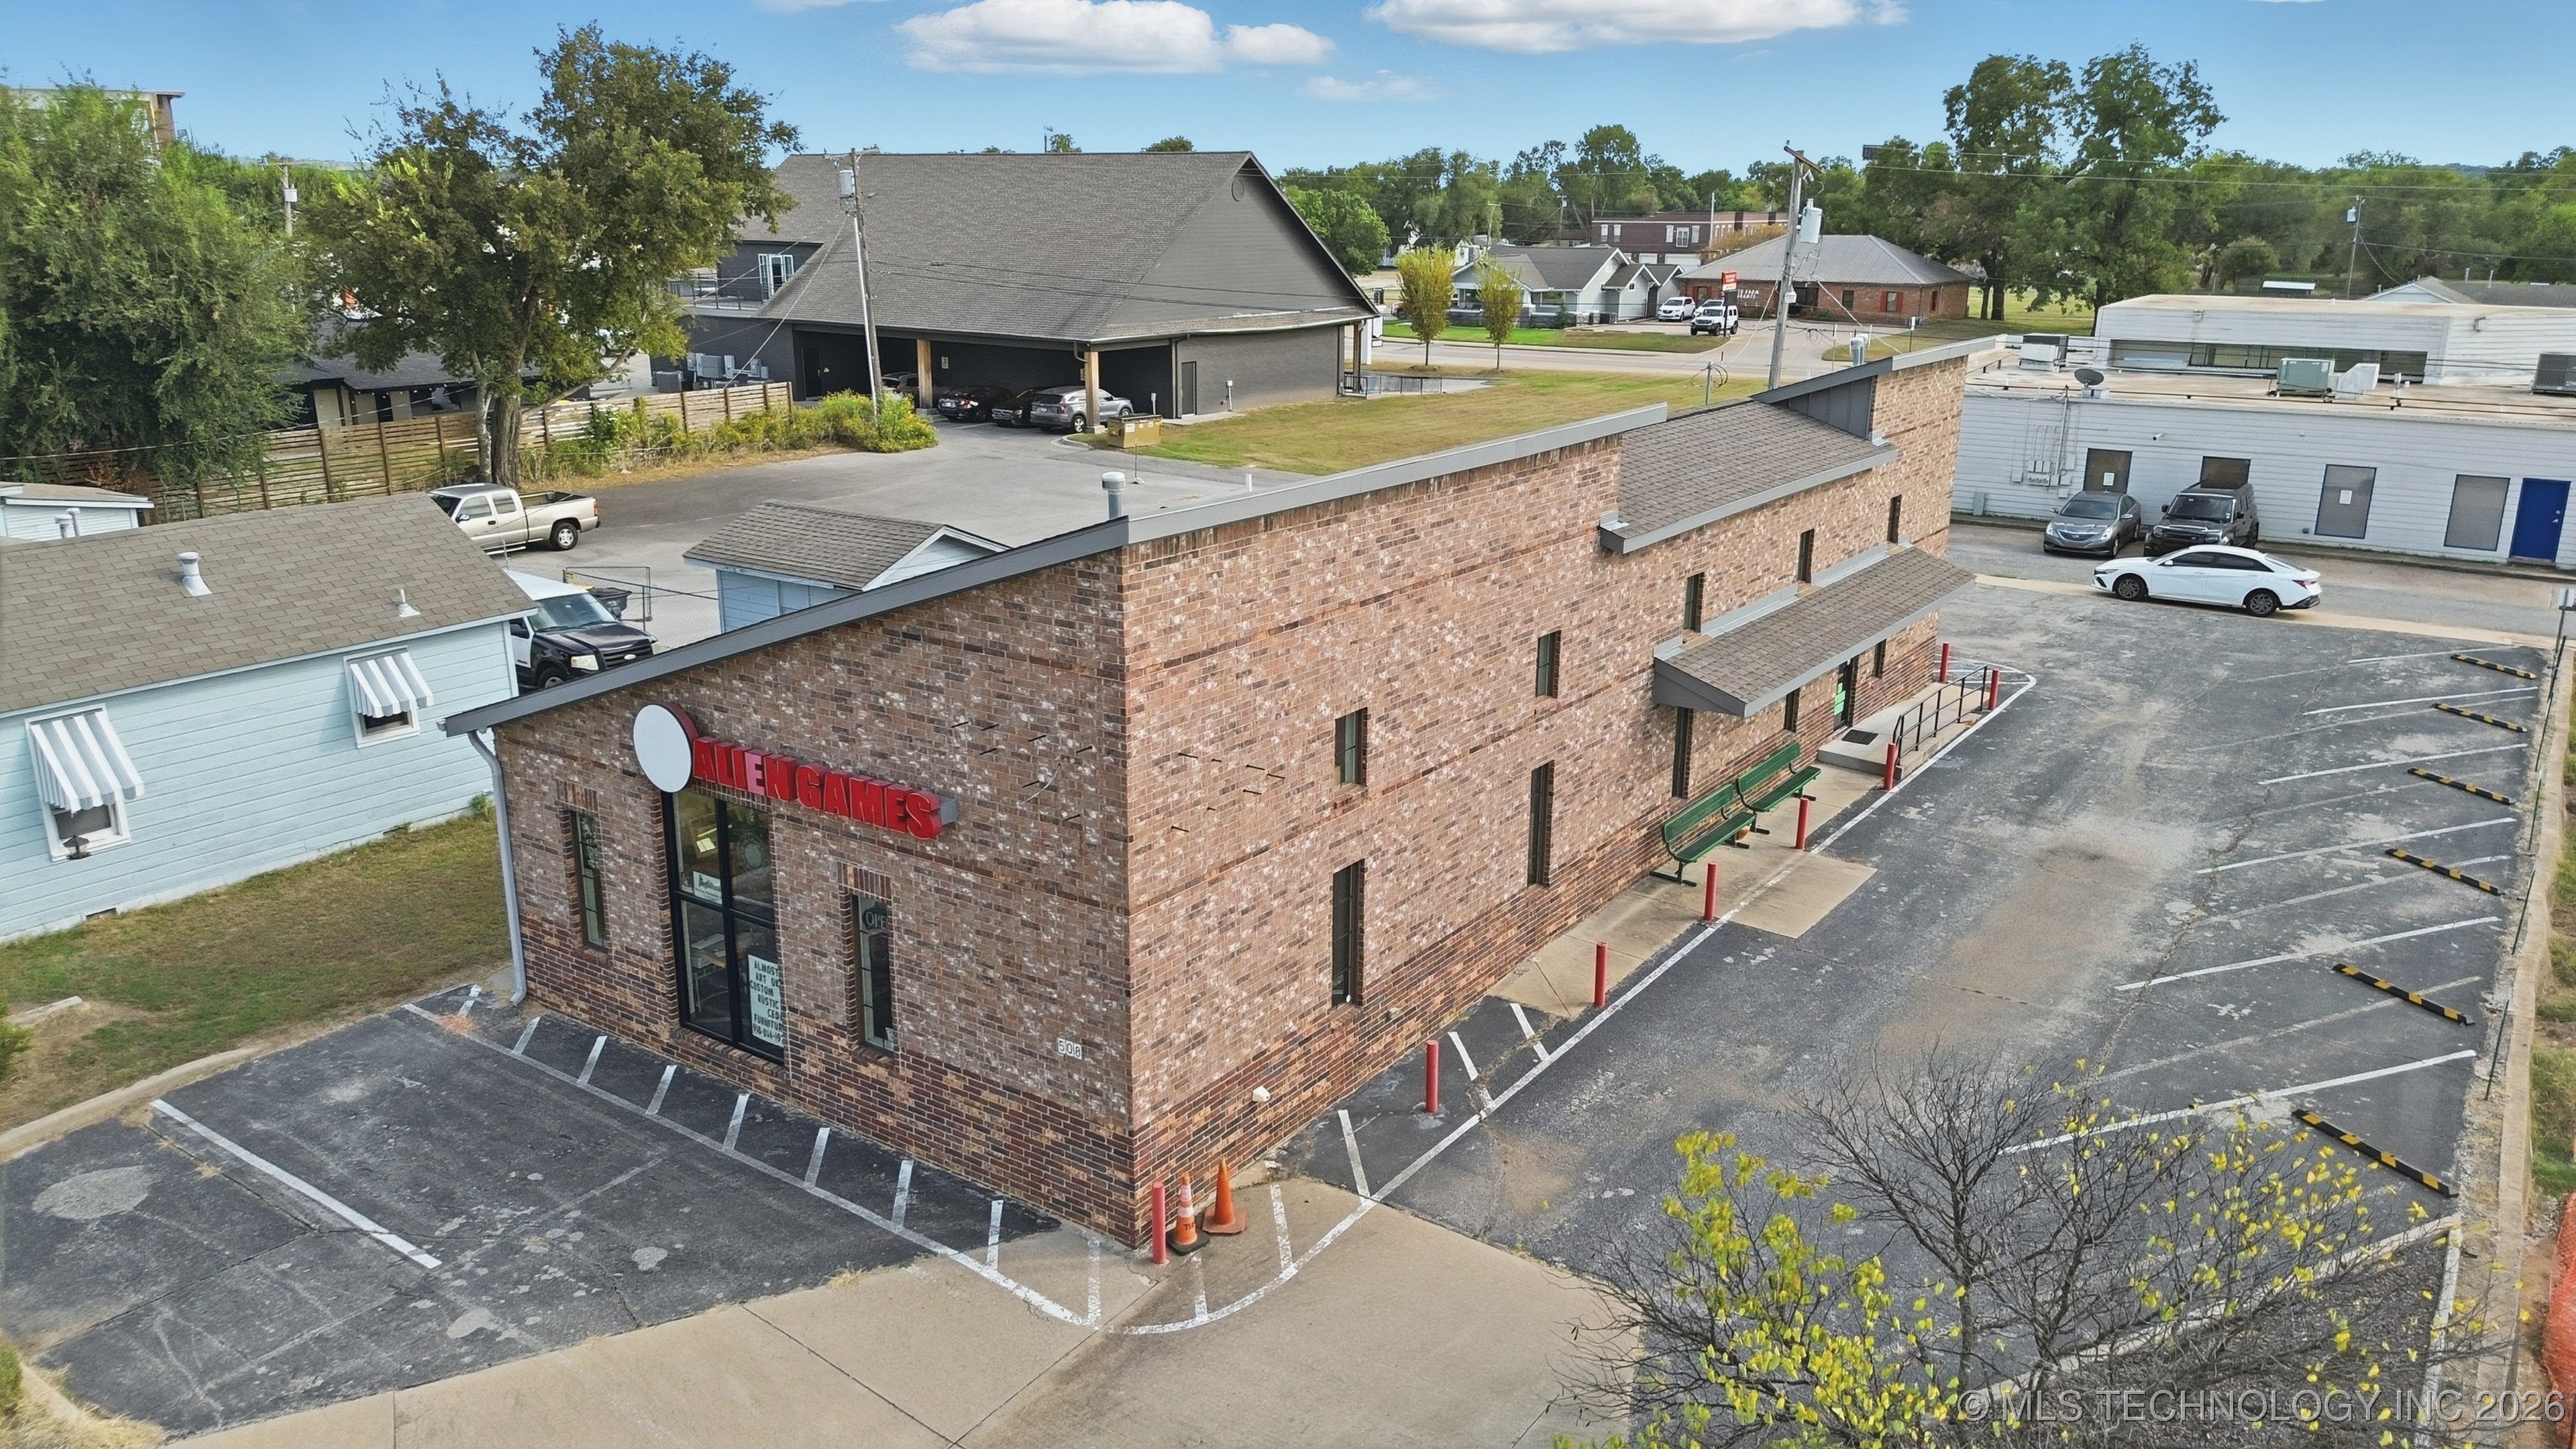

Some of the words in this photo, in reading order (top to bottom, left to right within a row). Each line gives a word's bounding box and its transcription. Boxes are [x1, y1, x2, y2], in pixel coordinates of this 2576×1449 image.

[693, 736, 797, 802] ALIEN
[796, 763, 942, 840] GAMES
[754, 961, 778, 977] ALMOST
[756, 971, 766, 984] ART
[750, 980, 774, 997] CUSTOM
[757, 994, 779, 1010] RUSTIC
[1059, 1040, 1081, 1058] 508
